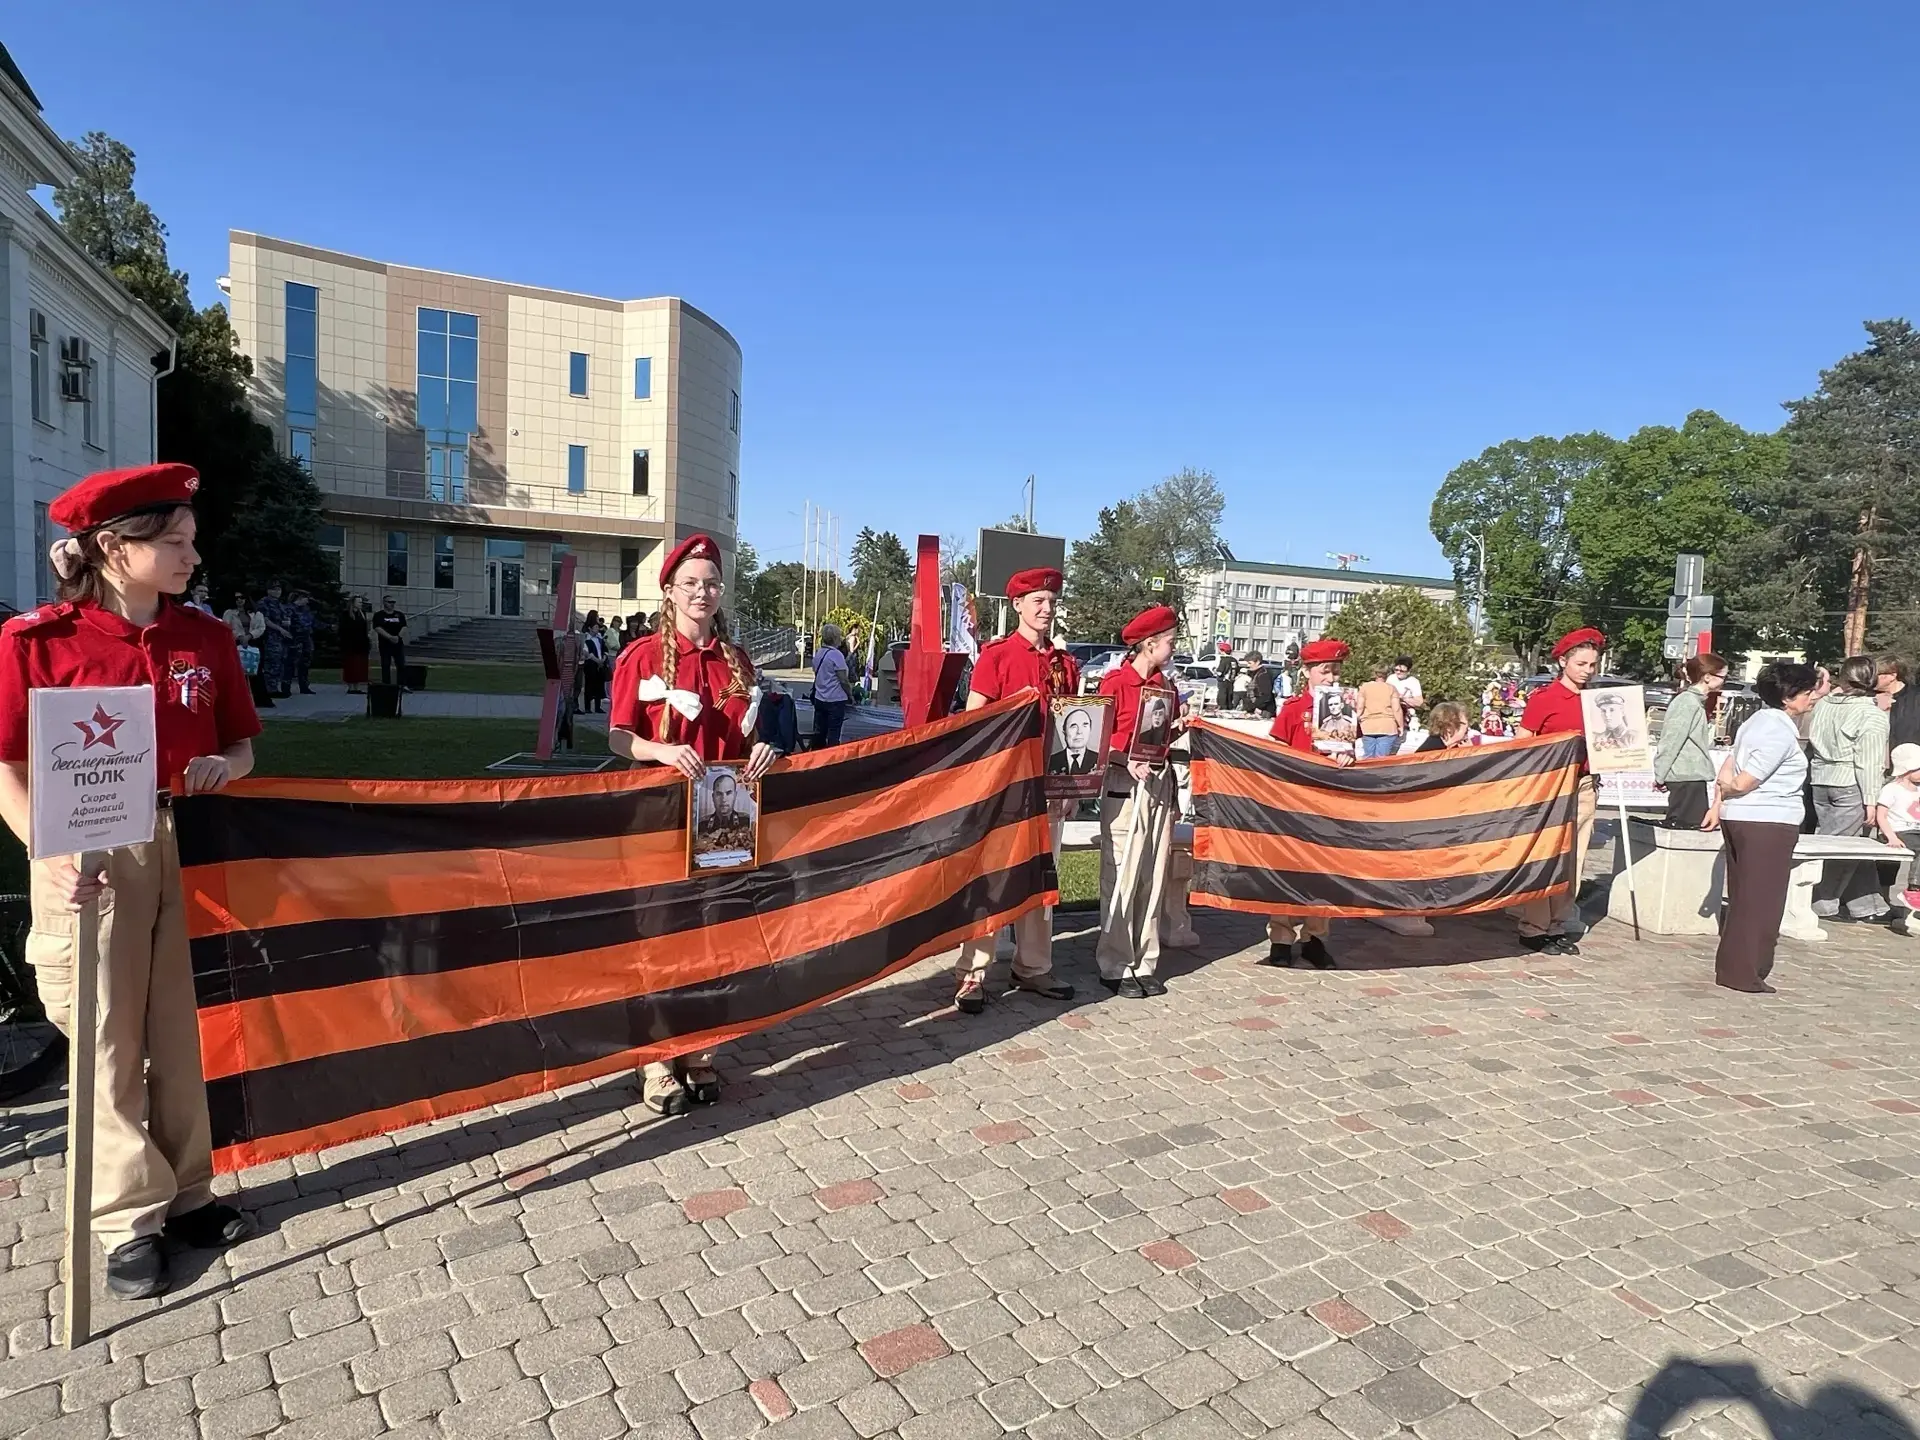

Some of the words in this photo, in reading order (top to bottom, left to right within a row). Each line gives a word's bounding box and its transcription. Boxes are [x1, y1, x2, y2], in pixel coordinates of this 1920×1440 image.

[74, 769, 125, 787] ПОЛК
[72, 802, 125, 817] Афанасий
[68, 814, 128, 829] Матвеевич
